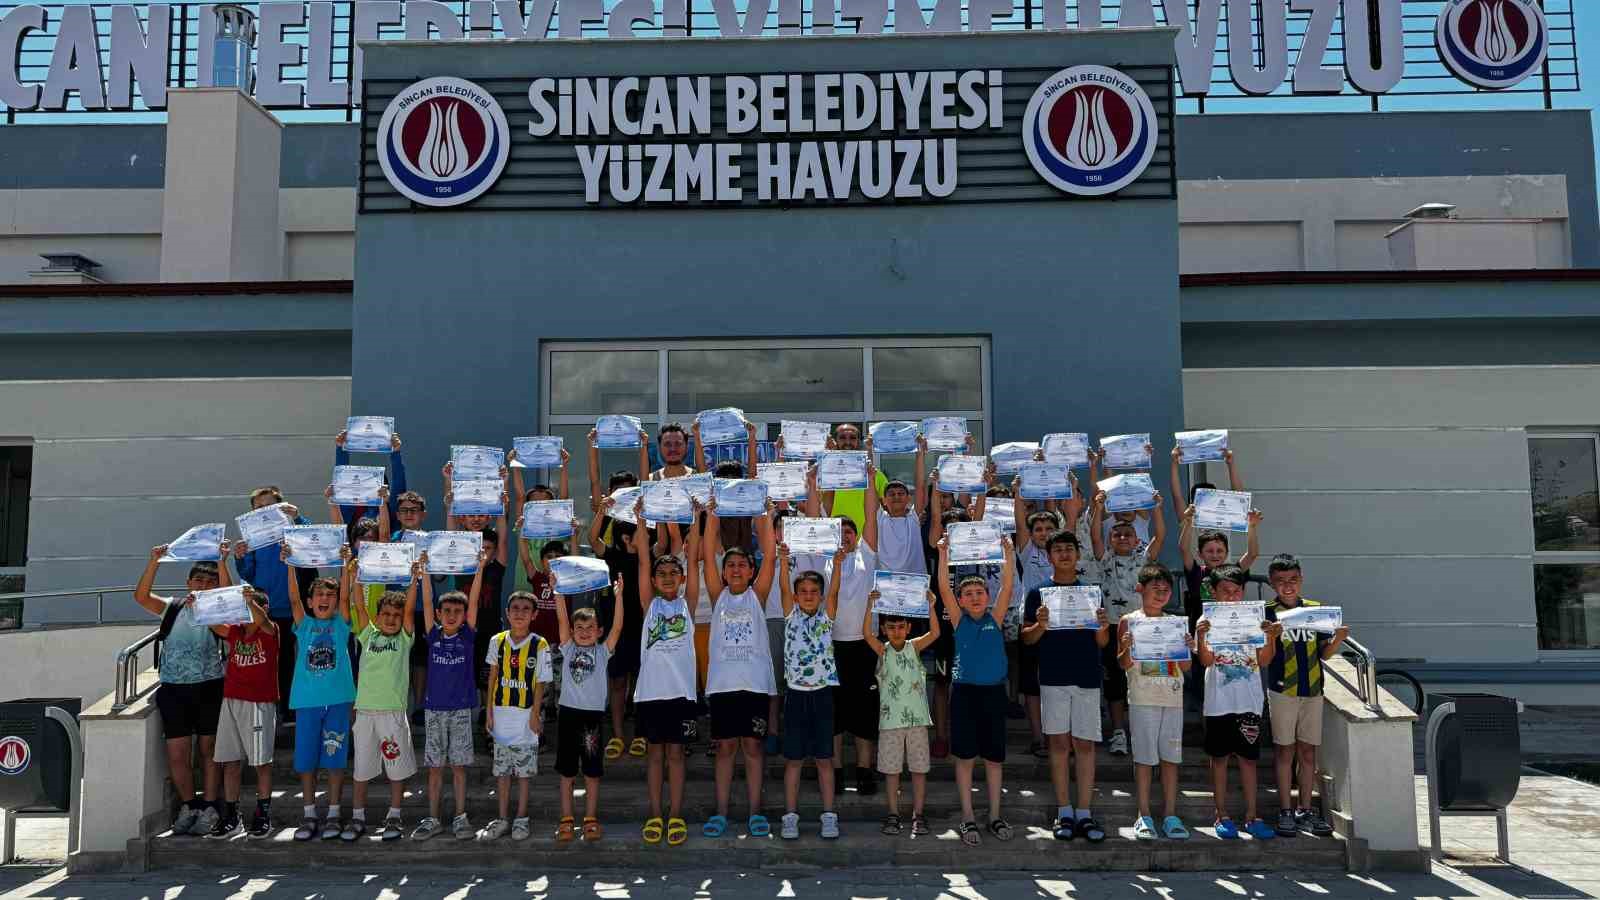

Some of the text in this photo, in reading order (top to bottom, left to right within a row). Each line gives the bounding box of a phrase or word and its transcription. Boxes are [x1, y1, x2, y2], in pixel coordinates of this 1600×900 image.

[399, 85, 491, 109] SİNCAN BELEDİYESİ
[1043, 73, 1136, 98] SİNCAN BELEDİYESİ
[527, 70, 1003, 137] SİNCAN BELEDİYESİ
[575, 138, 957, 202] YÜZME HAVUZU
[1280, 626, 1316, 642] AVIS
